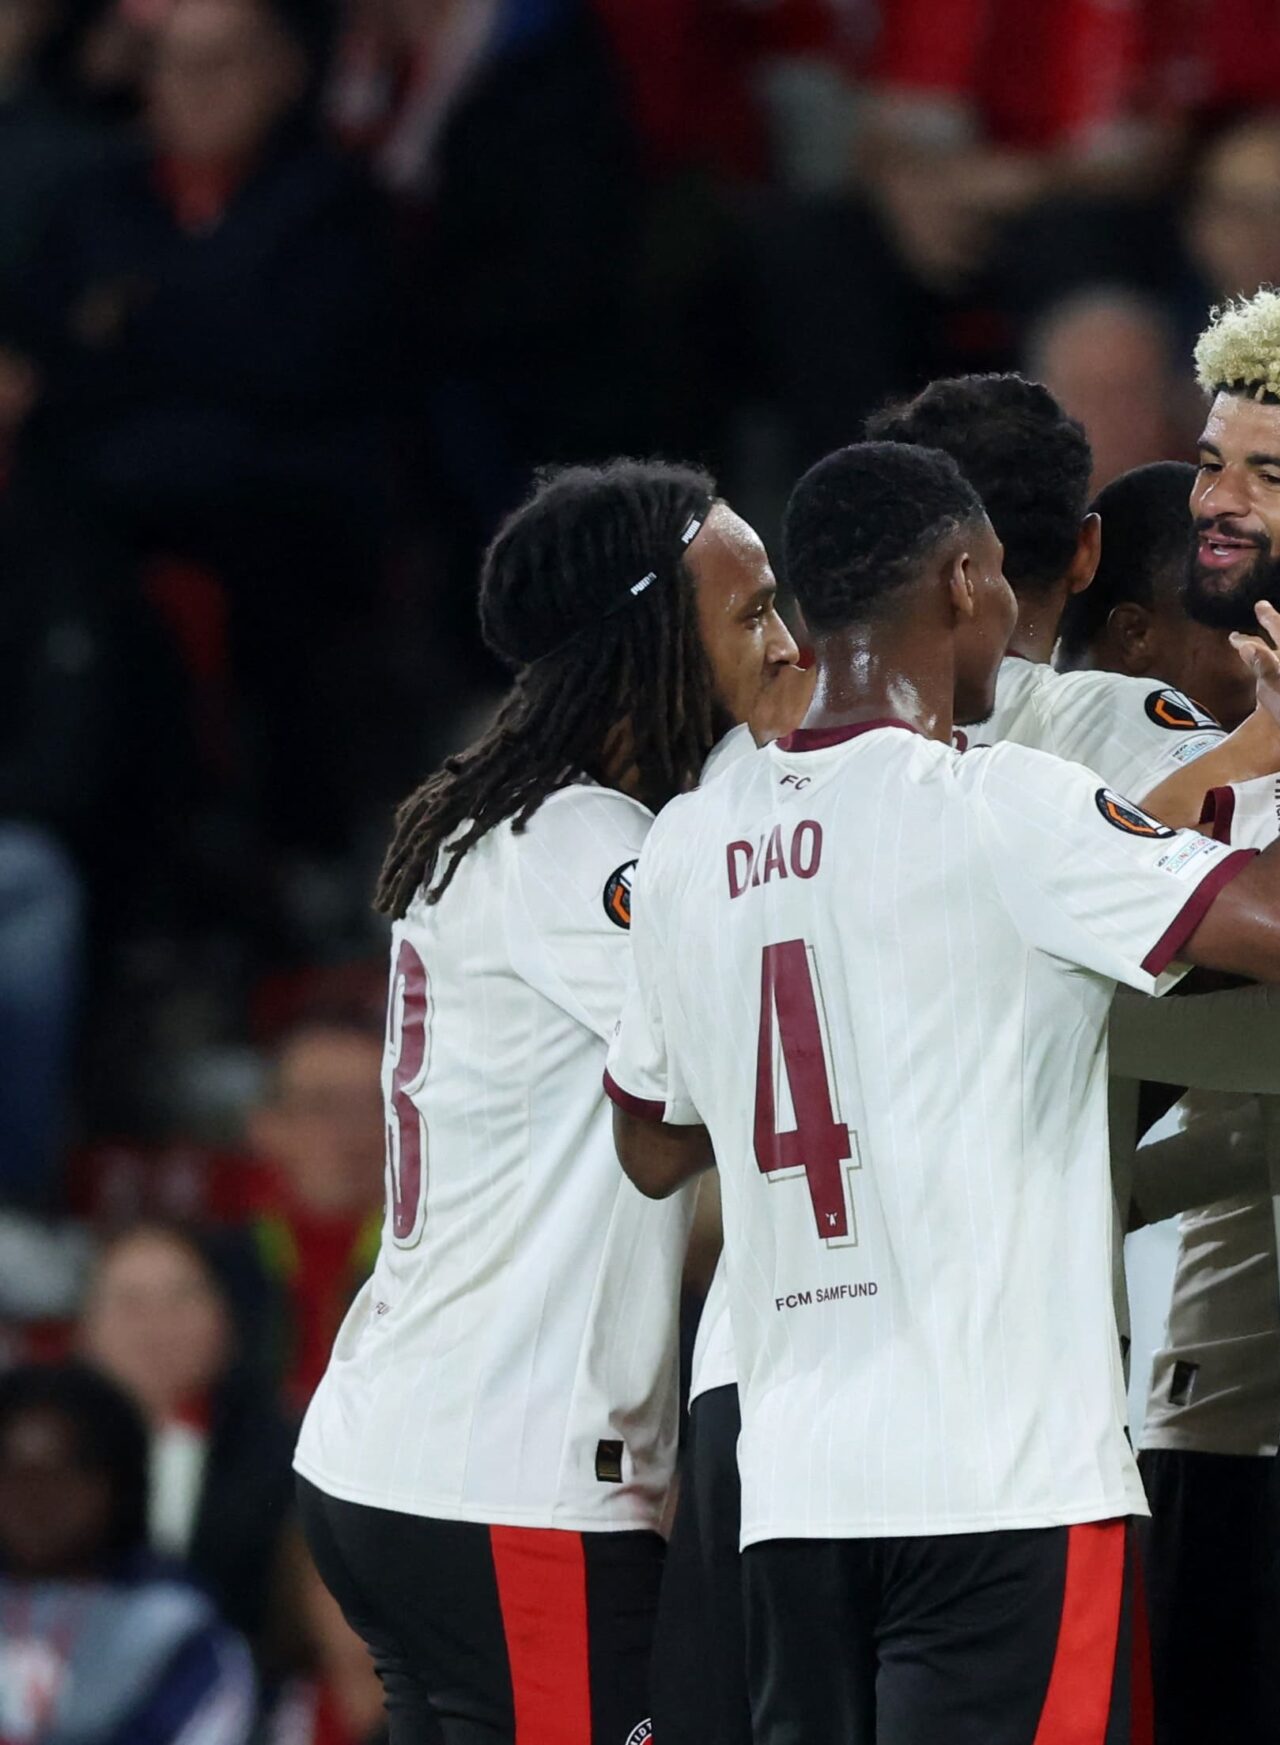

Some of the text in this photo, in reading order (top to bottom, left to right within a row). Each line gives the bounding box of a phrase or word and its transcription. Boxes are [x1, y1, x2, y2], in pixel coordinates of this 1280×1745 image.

[726, 819, 823, 900] DIAO
[753, 938, 859, 1247] 4
[775, 1282, 878, 1312] FCM SAMFUND
